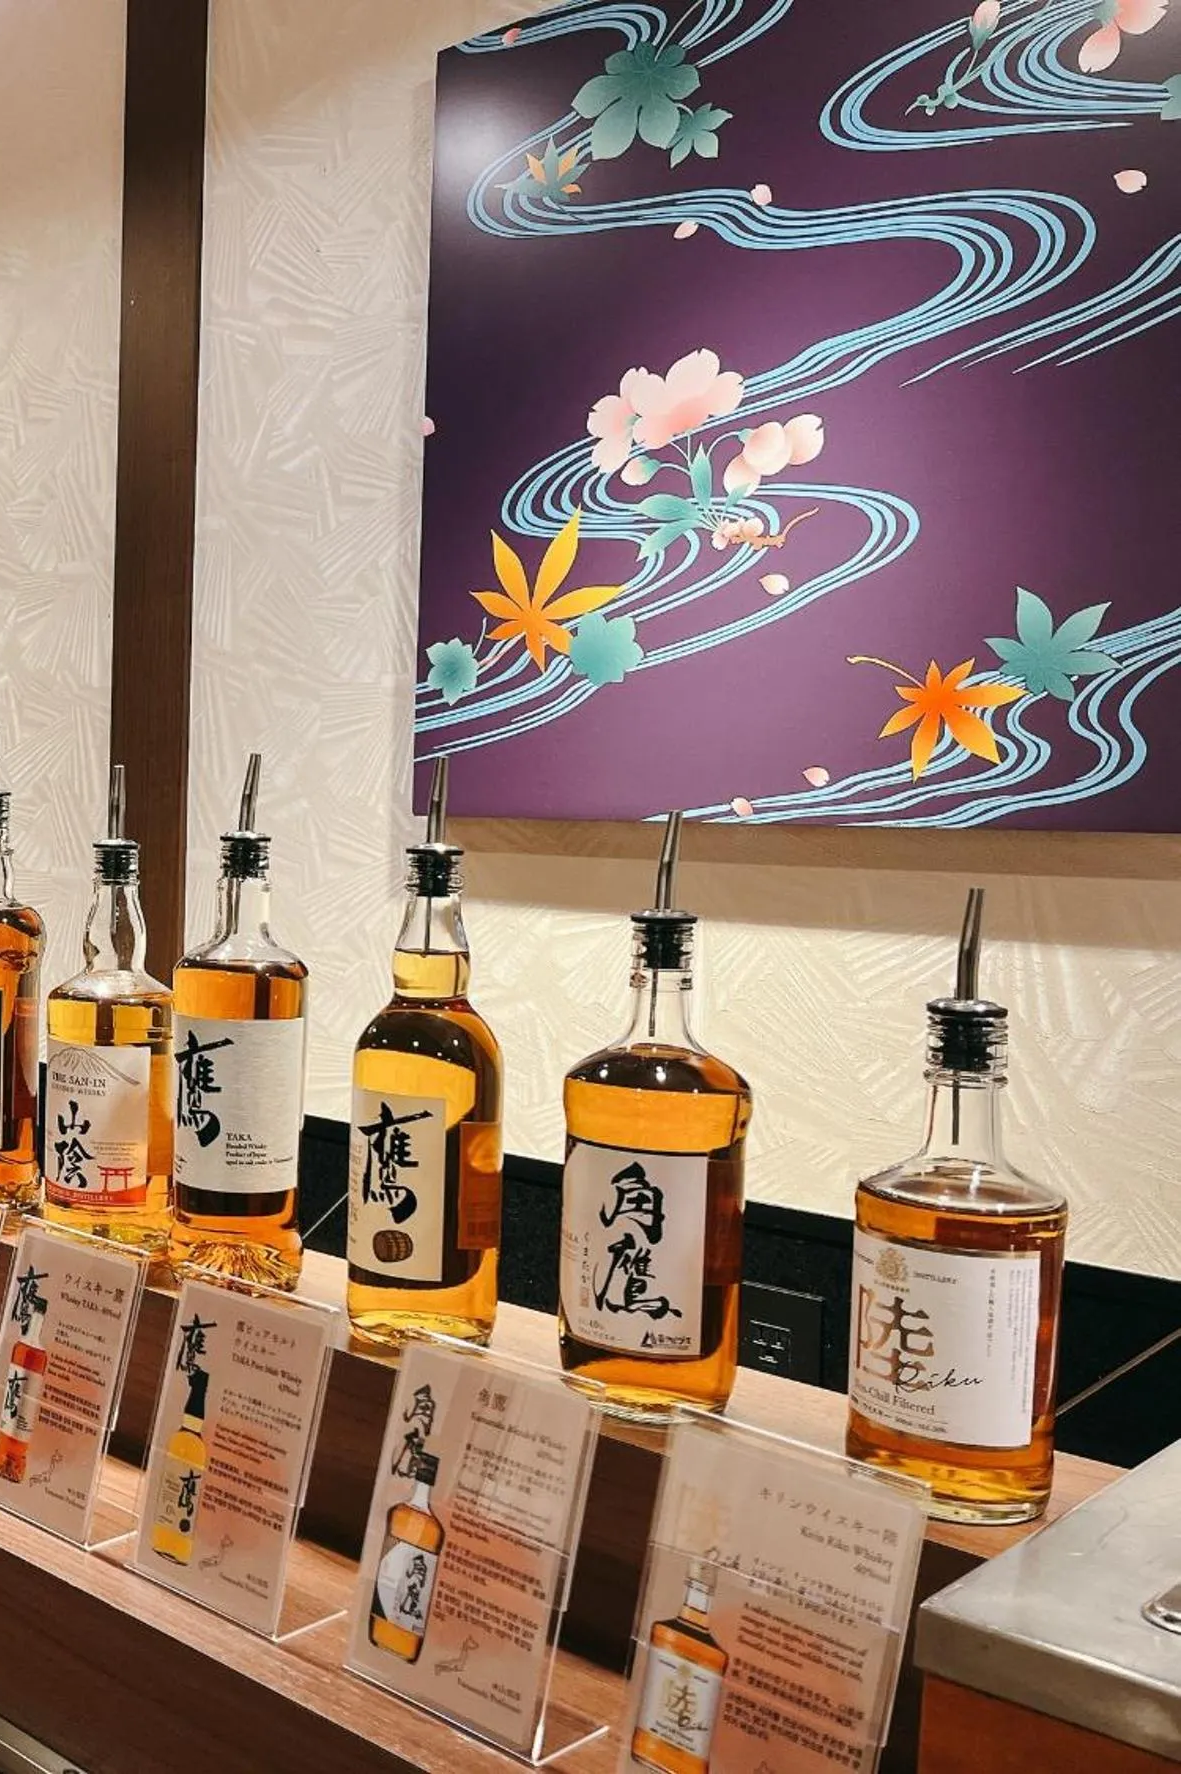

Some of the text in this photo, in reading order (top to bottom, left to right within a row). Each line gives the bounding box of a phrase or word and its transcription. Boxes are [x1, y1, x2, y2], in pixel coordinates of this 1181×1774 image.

[175, 1030, 235, 1148] 鷹
[54, 1100, 96, 1189] 山陰
[226, 1132, 253, 1142] TAKA
[358, 1101, 434, 1224] 鷹
[593, 1162, 683, 1320] 角鷹
[892, 1394, 935, 1416] Filtered
[895, 1361, 984, 1394] Riku
